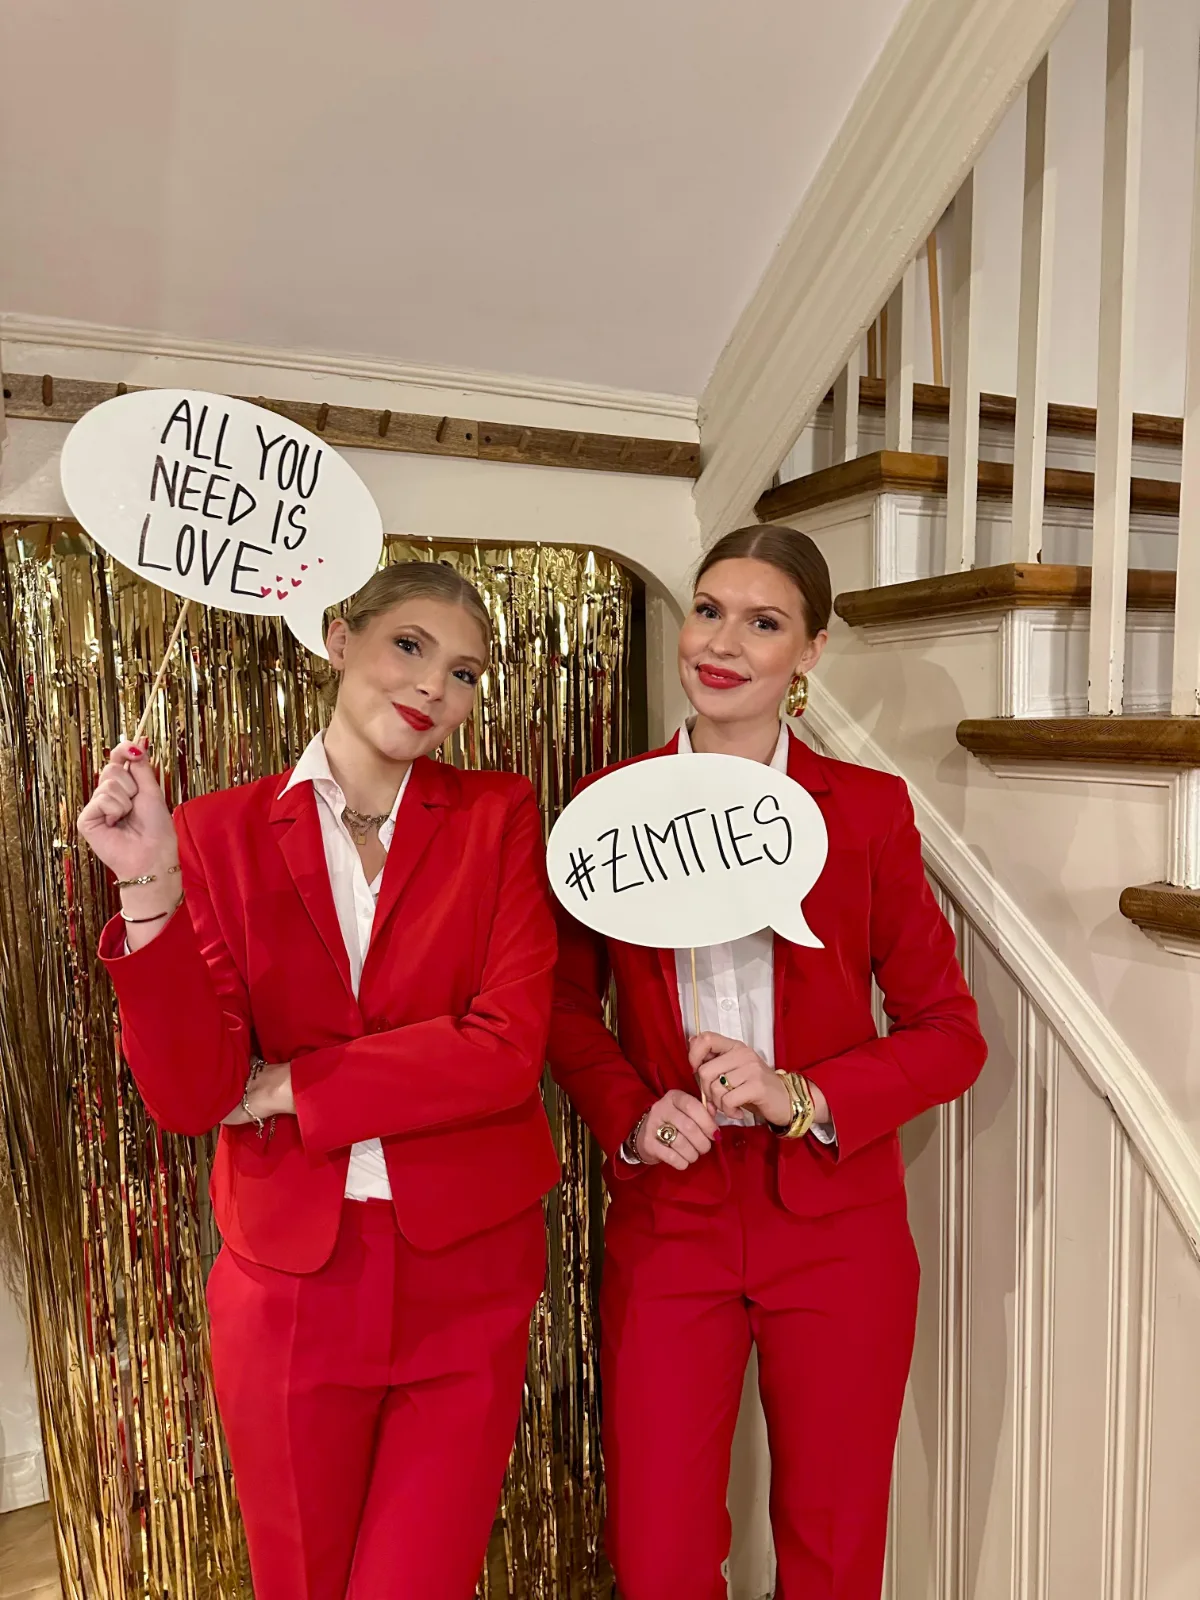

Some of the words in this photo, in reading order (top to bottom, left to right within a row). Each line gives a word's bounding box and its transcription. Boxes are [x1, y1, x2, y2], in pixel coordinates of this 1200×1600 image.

[160, 399, 233, 470] ALL
[256, 424, 323, 499] YOU
[150, 454, 257, 526] NEED
[271, 499, 307, 550] IS
[137, 513, 273, 599] LOVE
[565, 794, 793, 902] #ZIMTIES
